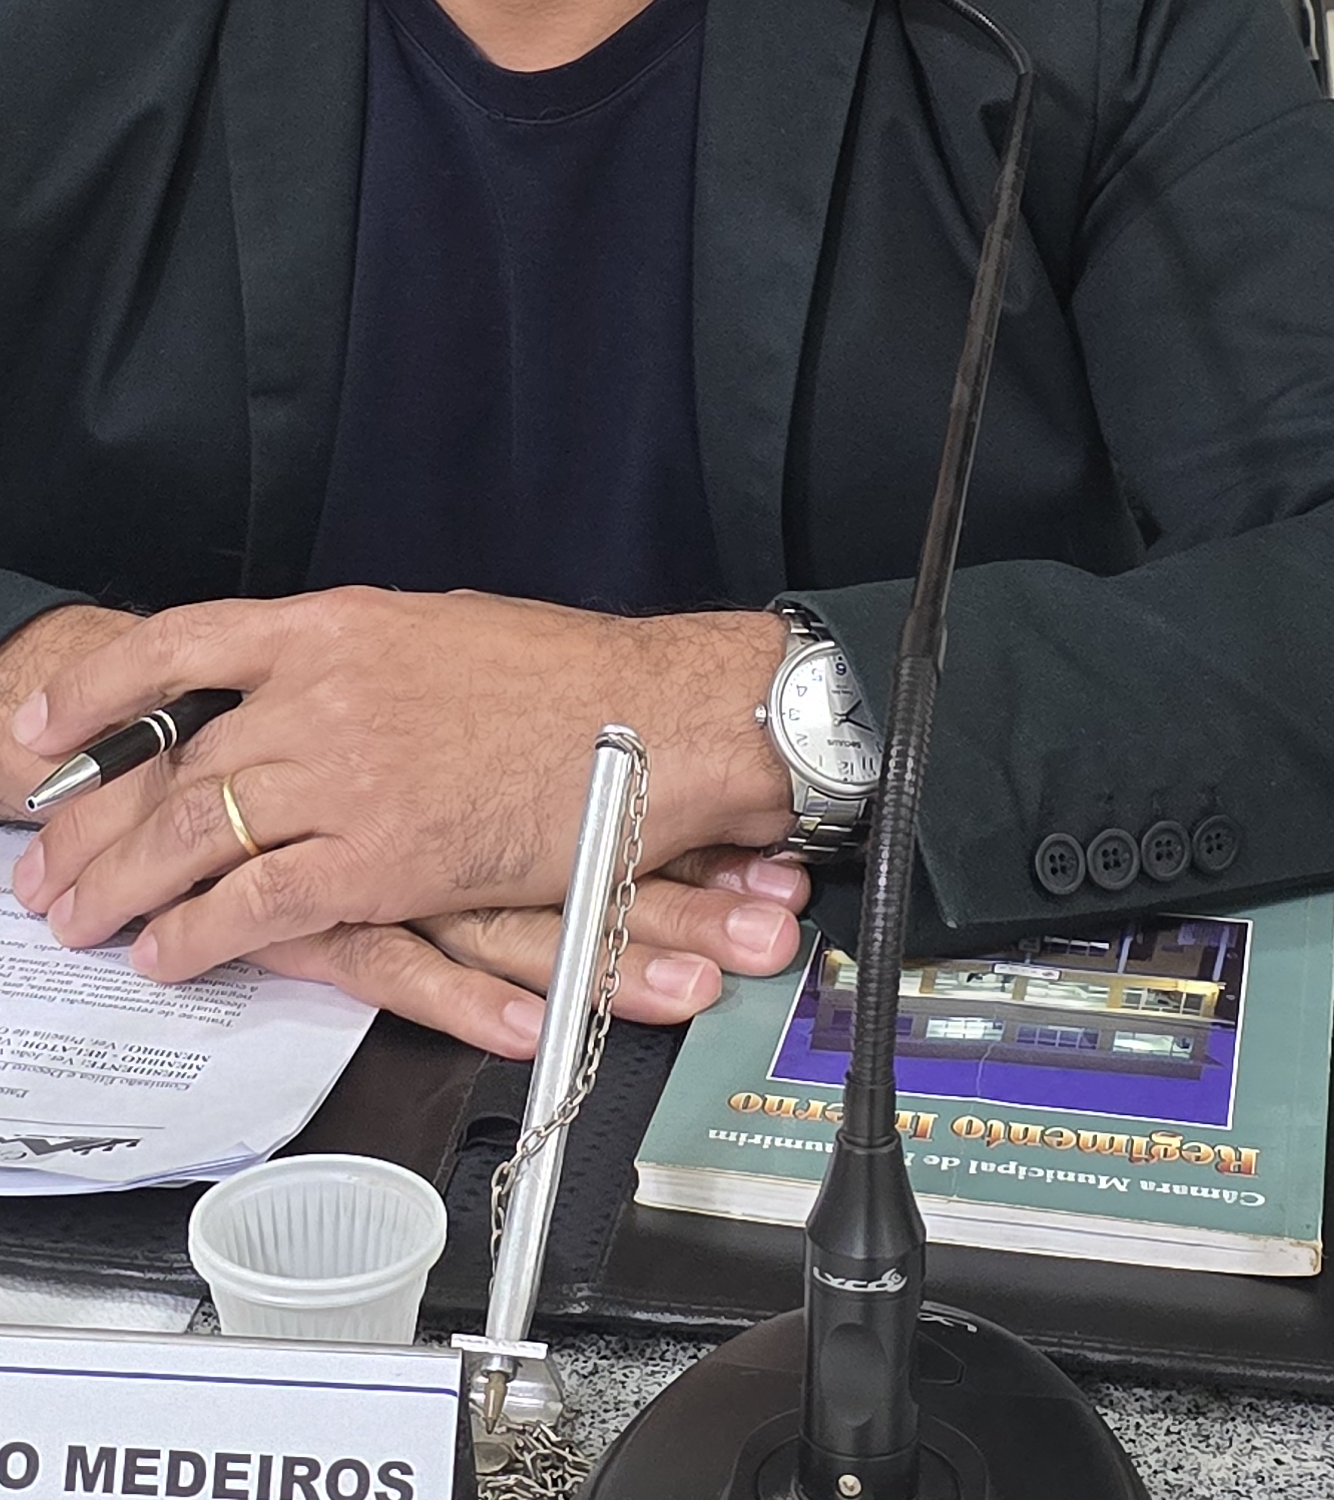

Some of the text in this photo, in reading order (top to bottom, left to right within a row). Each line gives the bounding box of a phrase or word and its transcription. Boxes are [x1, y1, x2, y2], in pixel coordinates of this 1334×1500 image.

[726, 1091, 1261, 1179] Regimento Inerno
[923, 1154, 961, 1171] de
[968, 1159, 1131, 1192] Municipal
[1139, 1180, 1266, 1207] Câmara
[63, 1445, 415, 1500] MEDEIROS
